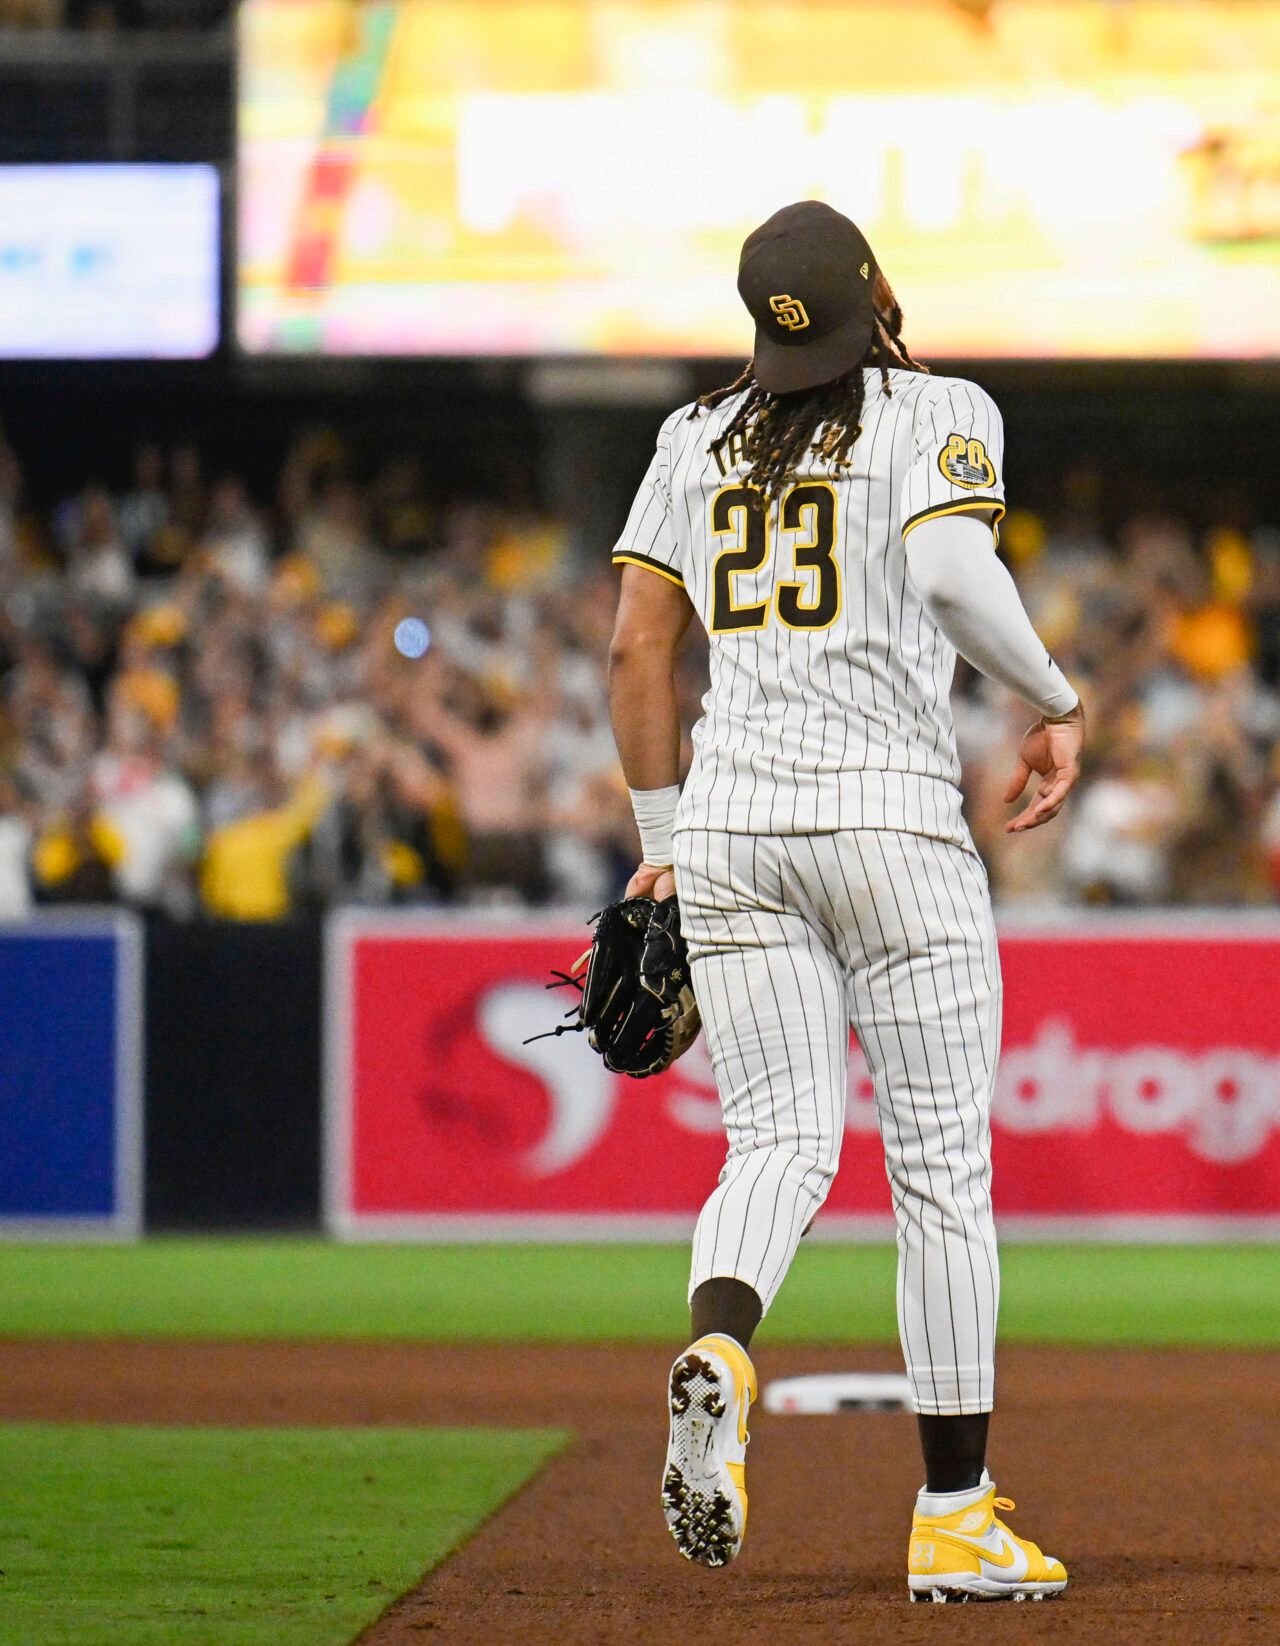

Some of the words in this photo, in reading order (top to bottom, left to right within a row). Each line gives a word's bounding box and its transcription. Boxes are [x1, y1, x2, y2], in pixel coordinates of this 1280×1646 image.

[769, 294, 810, 331] SD
[947, 434, 986, 472] 20
[709, 480, 842, 635] 23
